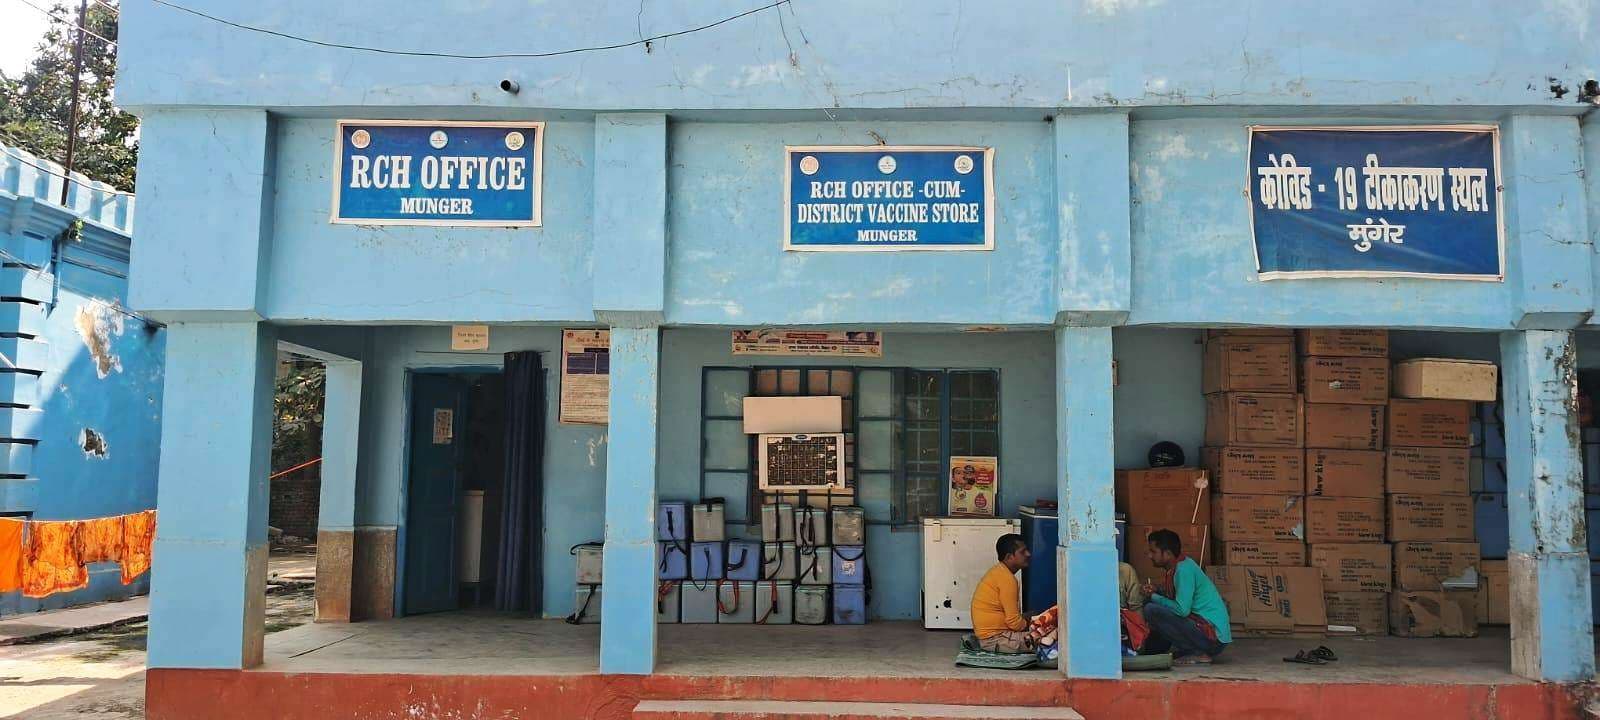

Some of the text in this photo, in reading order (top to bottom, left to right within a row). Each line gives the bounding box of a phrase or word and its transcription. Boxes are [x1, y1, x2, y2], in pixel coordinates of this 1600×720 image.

[350, 154, 526, 191] RCH OFFICE
[1257, 153, 1312, 210] कोविड
[1334, 166, 1358, 210] 19
[1363, 153, 1445, 212] टीकाकरण
[1449, 166, 1489, 212] स्थल
[810, 180, 966, 198] RCH OFFICE -CUM-
[400, 197, 473, 215] MUNGER
[797, 202, 979, 224] DISTRICT VACCINE STORE
[857, 229, 918, 242] MUNGER
[1346, 217, 1406, 253] मुंगेर
